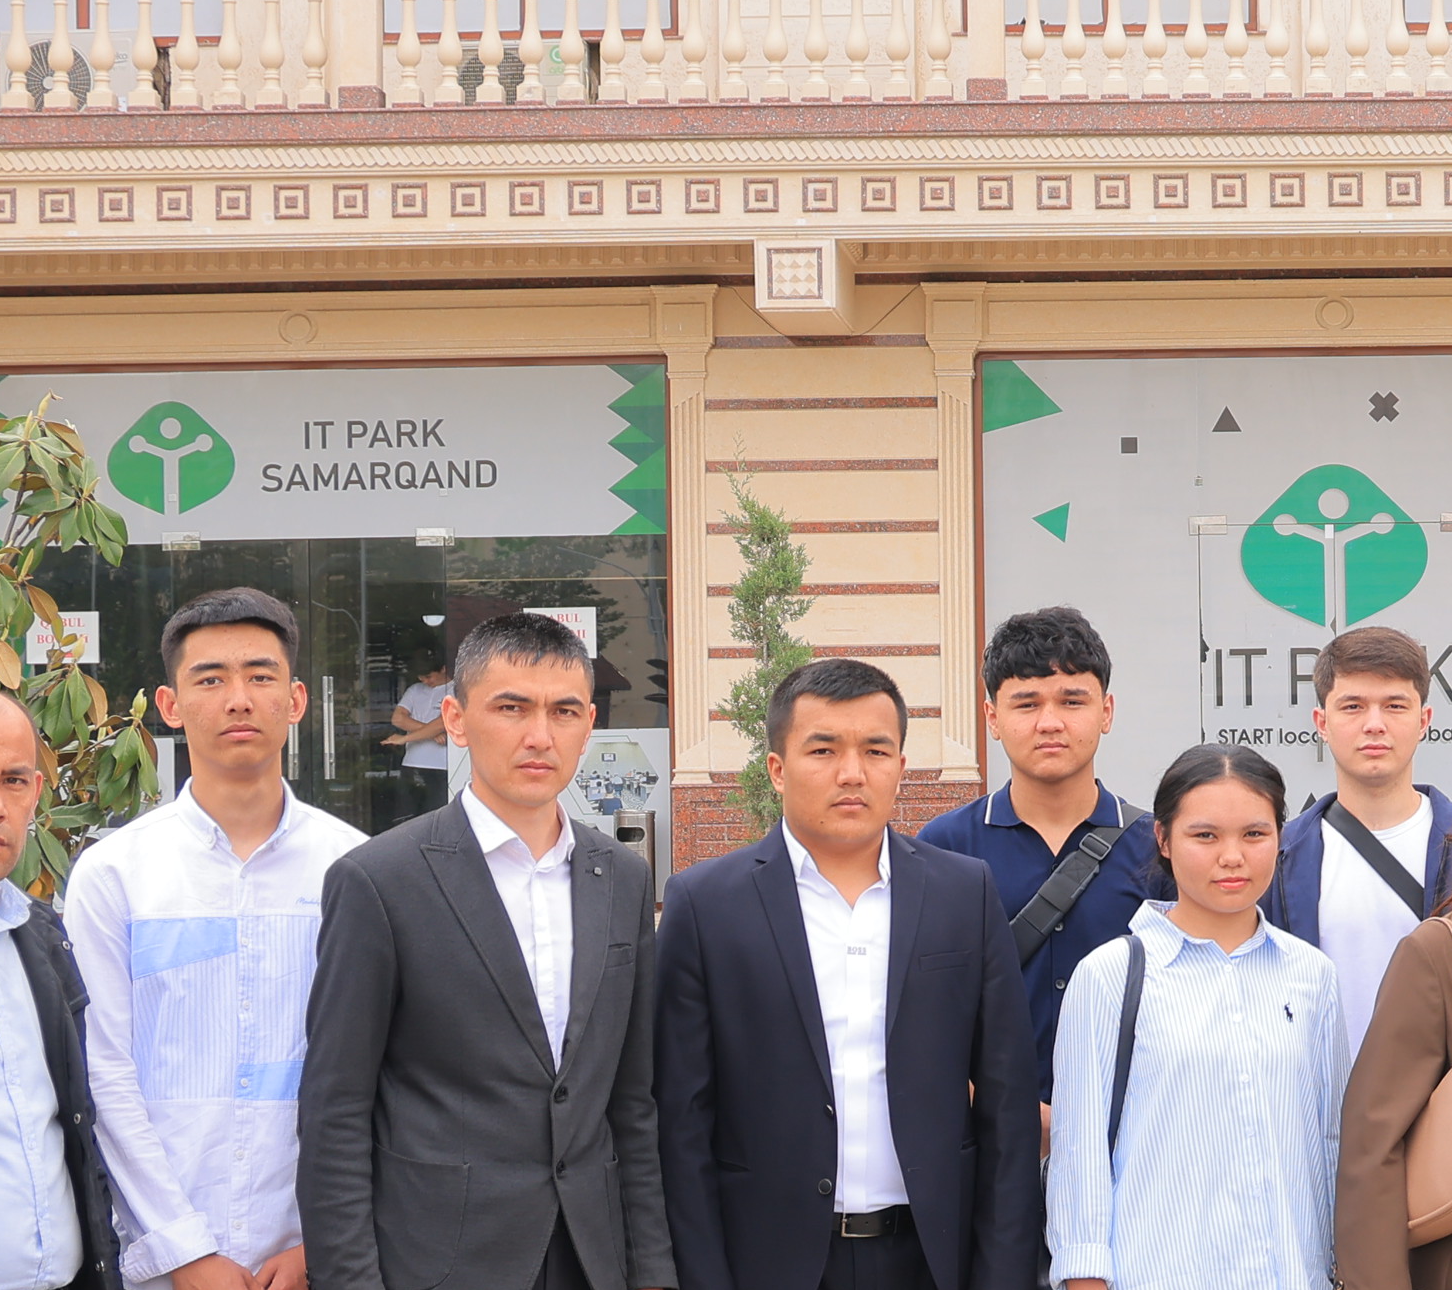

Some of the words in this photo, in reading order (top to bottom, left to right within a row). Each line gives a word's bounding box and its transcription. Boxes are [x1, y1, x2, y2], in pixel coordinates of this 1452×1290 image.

[304, 421, 335, 450] IT
[347, 418, 446, 449] PARK
[261, 459, 498, 492] SAMARQAND
[1214, 647, 1268, 707] IT
[1218, 727, 1273, 745] START
